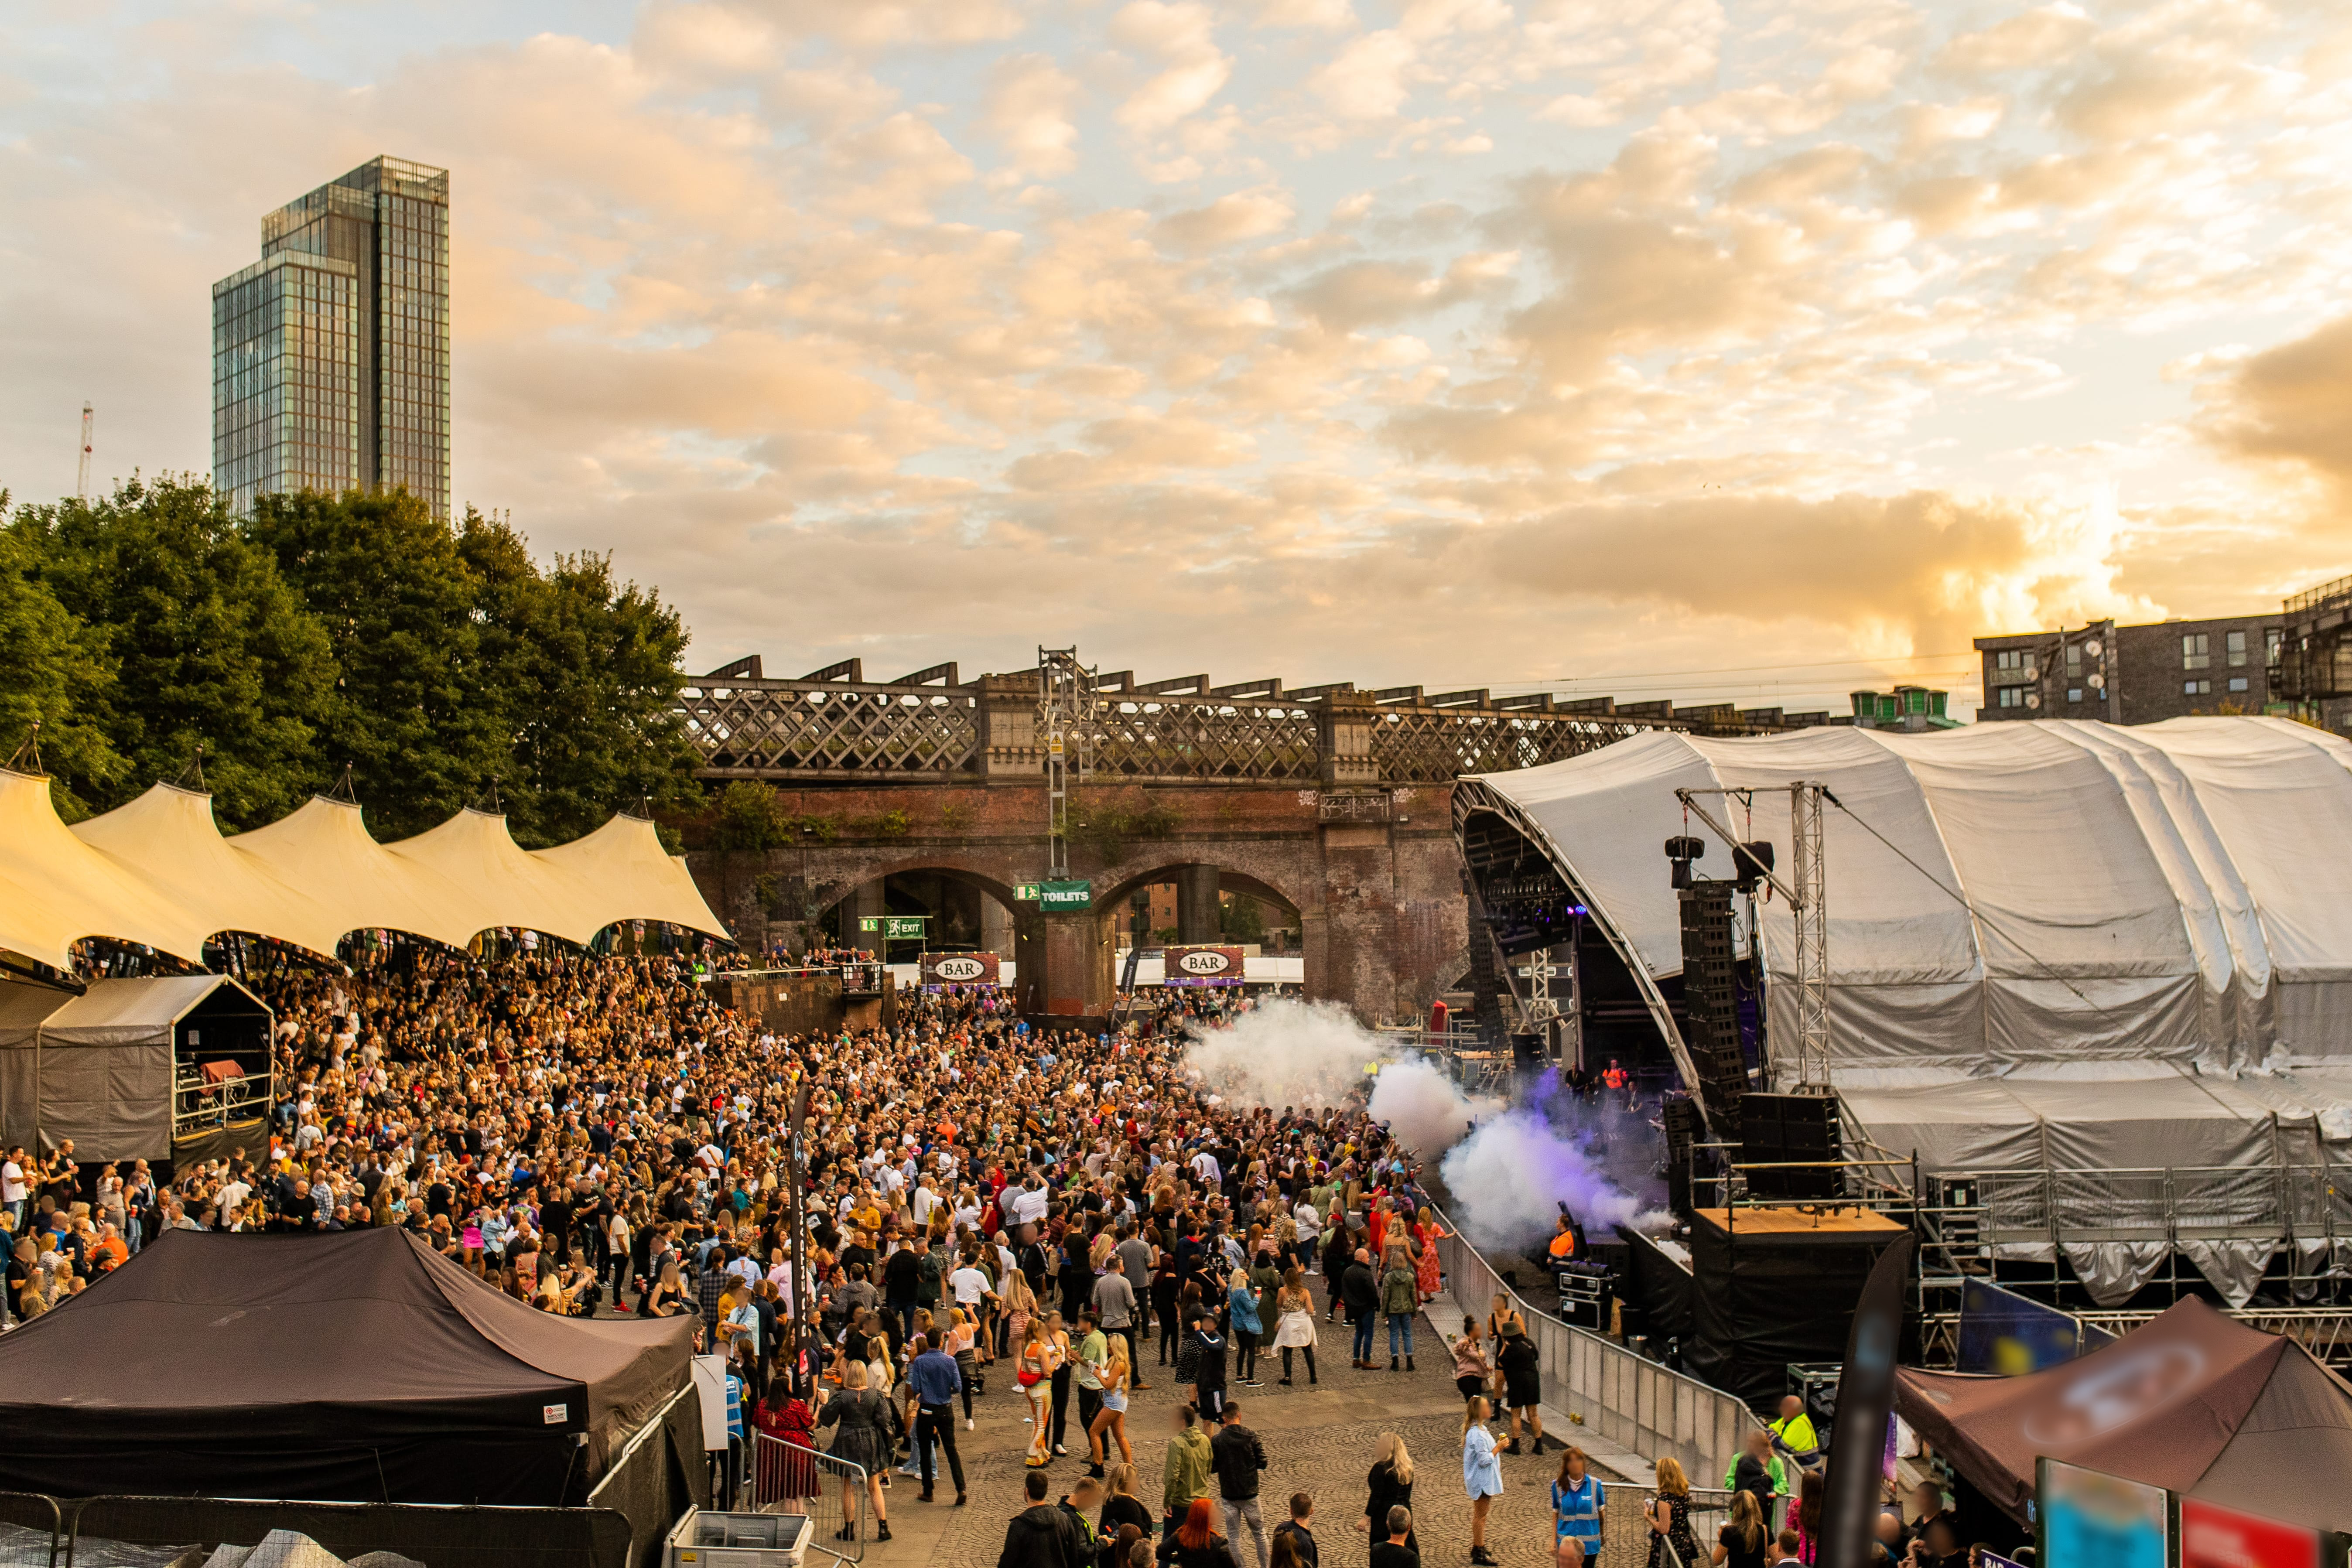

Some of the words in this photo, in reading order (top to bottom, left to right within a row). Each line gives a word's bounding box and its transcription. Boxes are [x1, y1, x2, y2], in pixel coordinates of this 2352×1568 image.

[1042, 892, 1089, 902] TOILETS
[902, 924, 920, 932] EXIT
[1189, 957, 1220, 969] BAR
[944, 963, 975, 975] BAR
